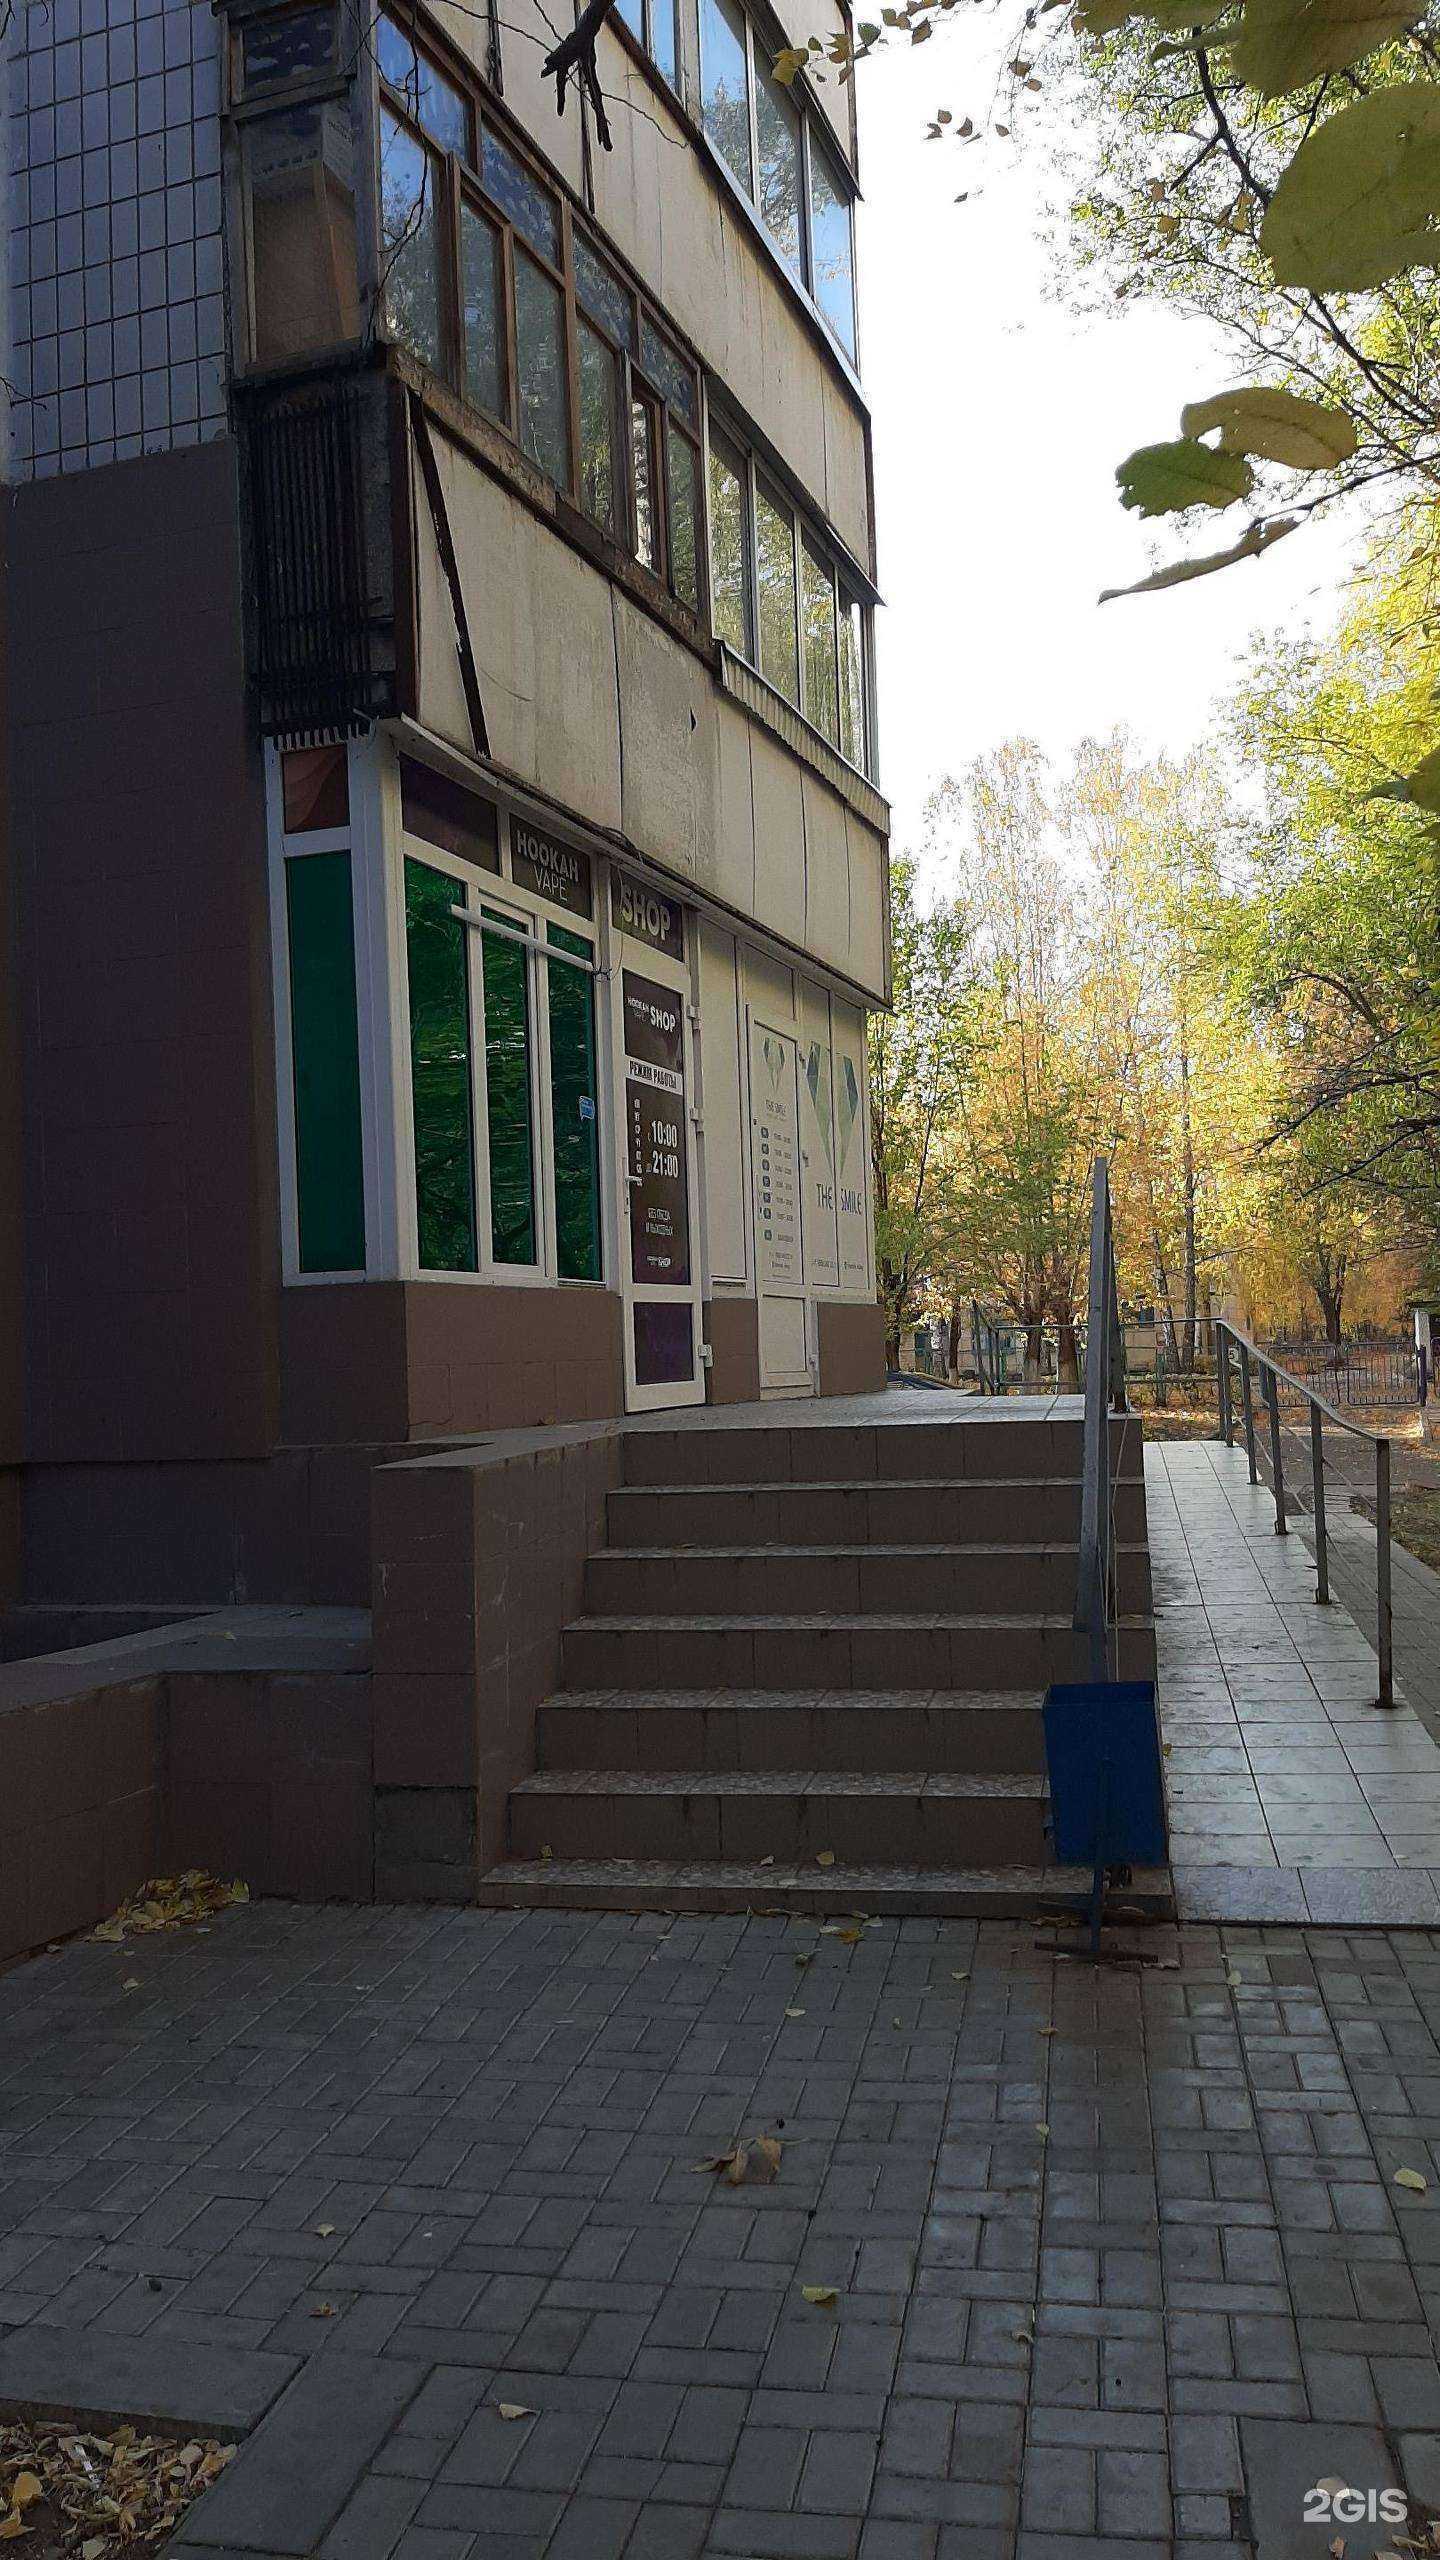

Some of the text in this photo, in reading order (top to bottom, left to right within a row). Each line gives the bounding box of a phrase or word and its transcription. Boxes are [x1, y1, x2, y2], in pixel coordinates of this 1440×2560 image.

[516, 830, 578, 882] HOOKAH
[534, 865, 568, 901] VAPE
[621, 883, 670, 940] SHOP
[650, 1005, 676, 1032] SHOP
[651, 1120, 677, 1148] 10:00
[652, 1150, 679, 1178] 21:00
[816, 1183, 833, 1211] THE
[840, 1187, 862, 1216] SMILE
